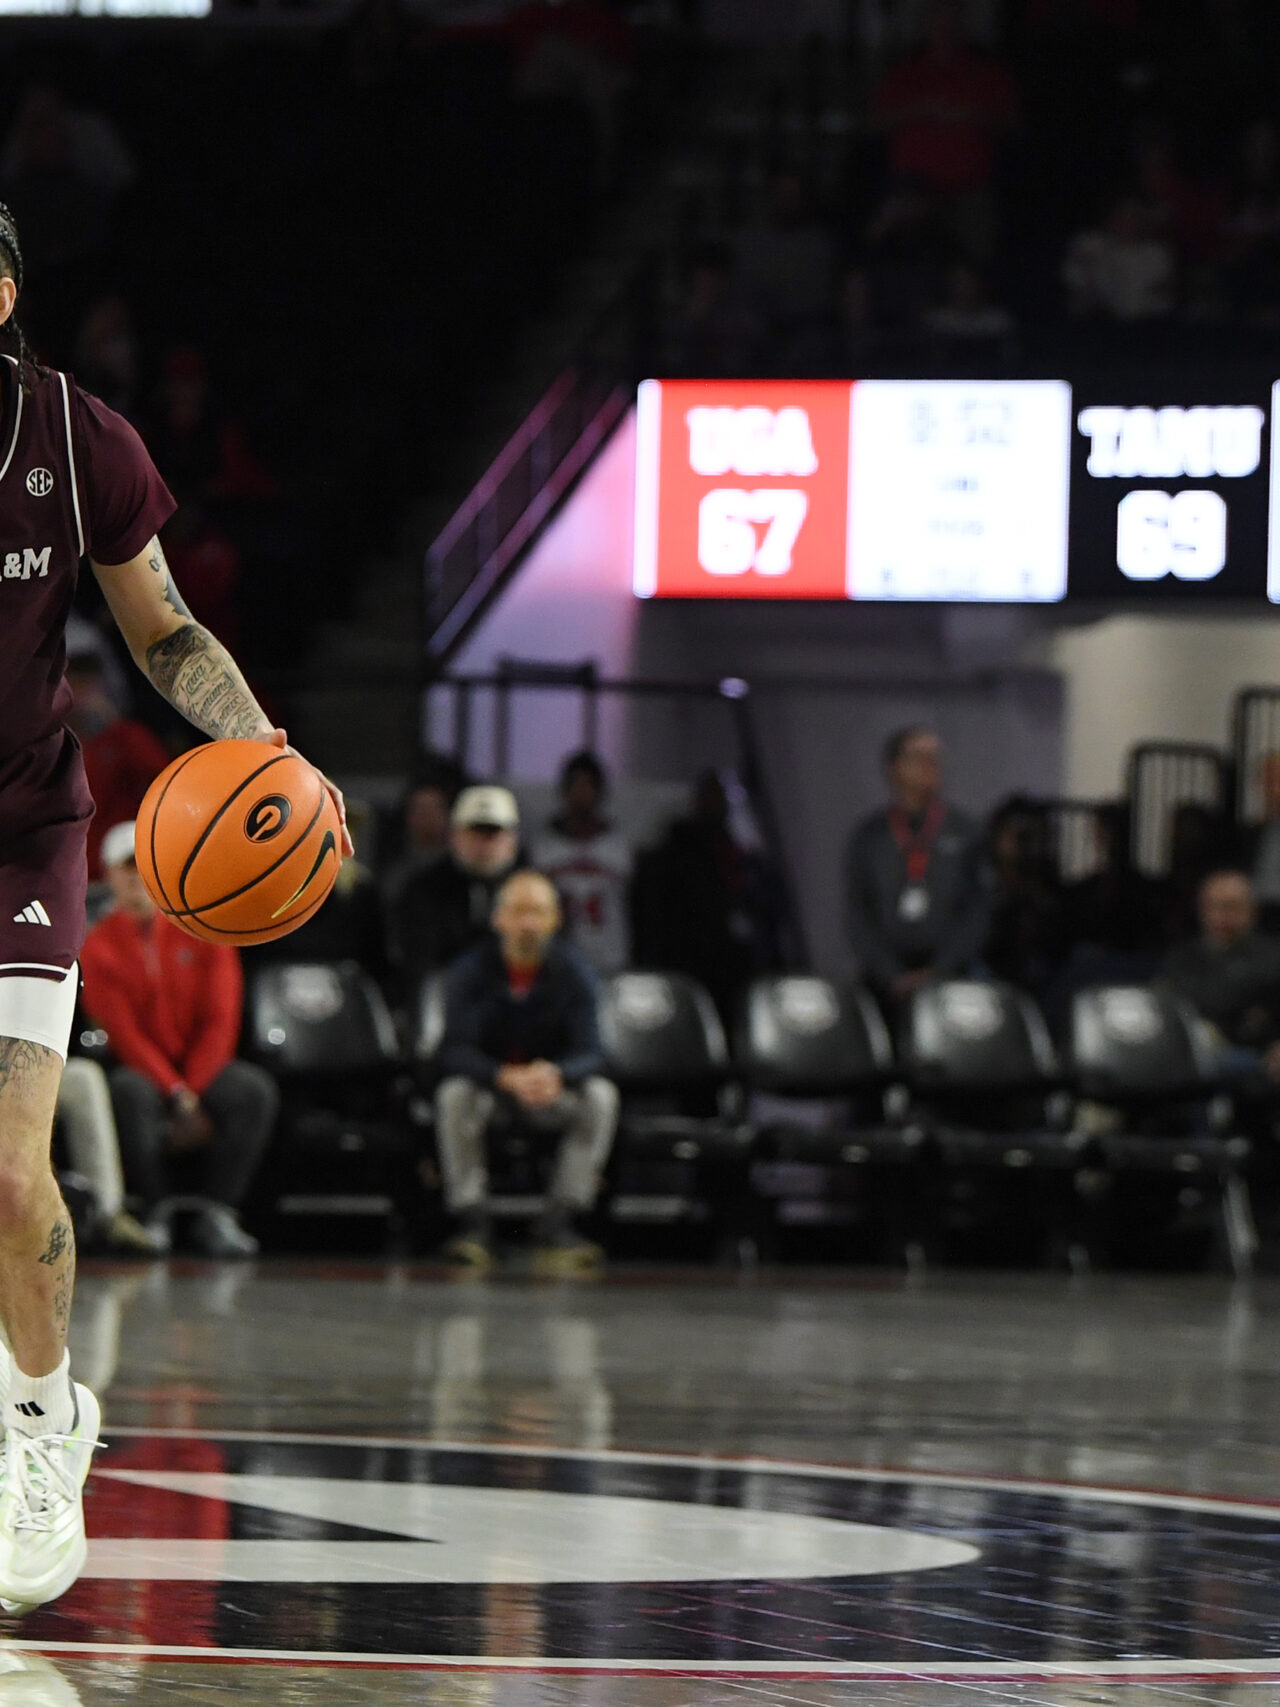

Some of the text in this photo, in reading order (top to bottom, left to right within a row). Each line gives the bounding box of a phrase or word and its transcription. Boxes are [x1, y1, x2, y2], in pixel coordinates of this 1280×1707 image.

[686, 405, 819, 476] UGA
[27, 472, 52, 494] SEC
[698, 489, 807, 576] 67
[1117, 489, 1227, 581] 69
